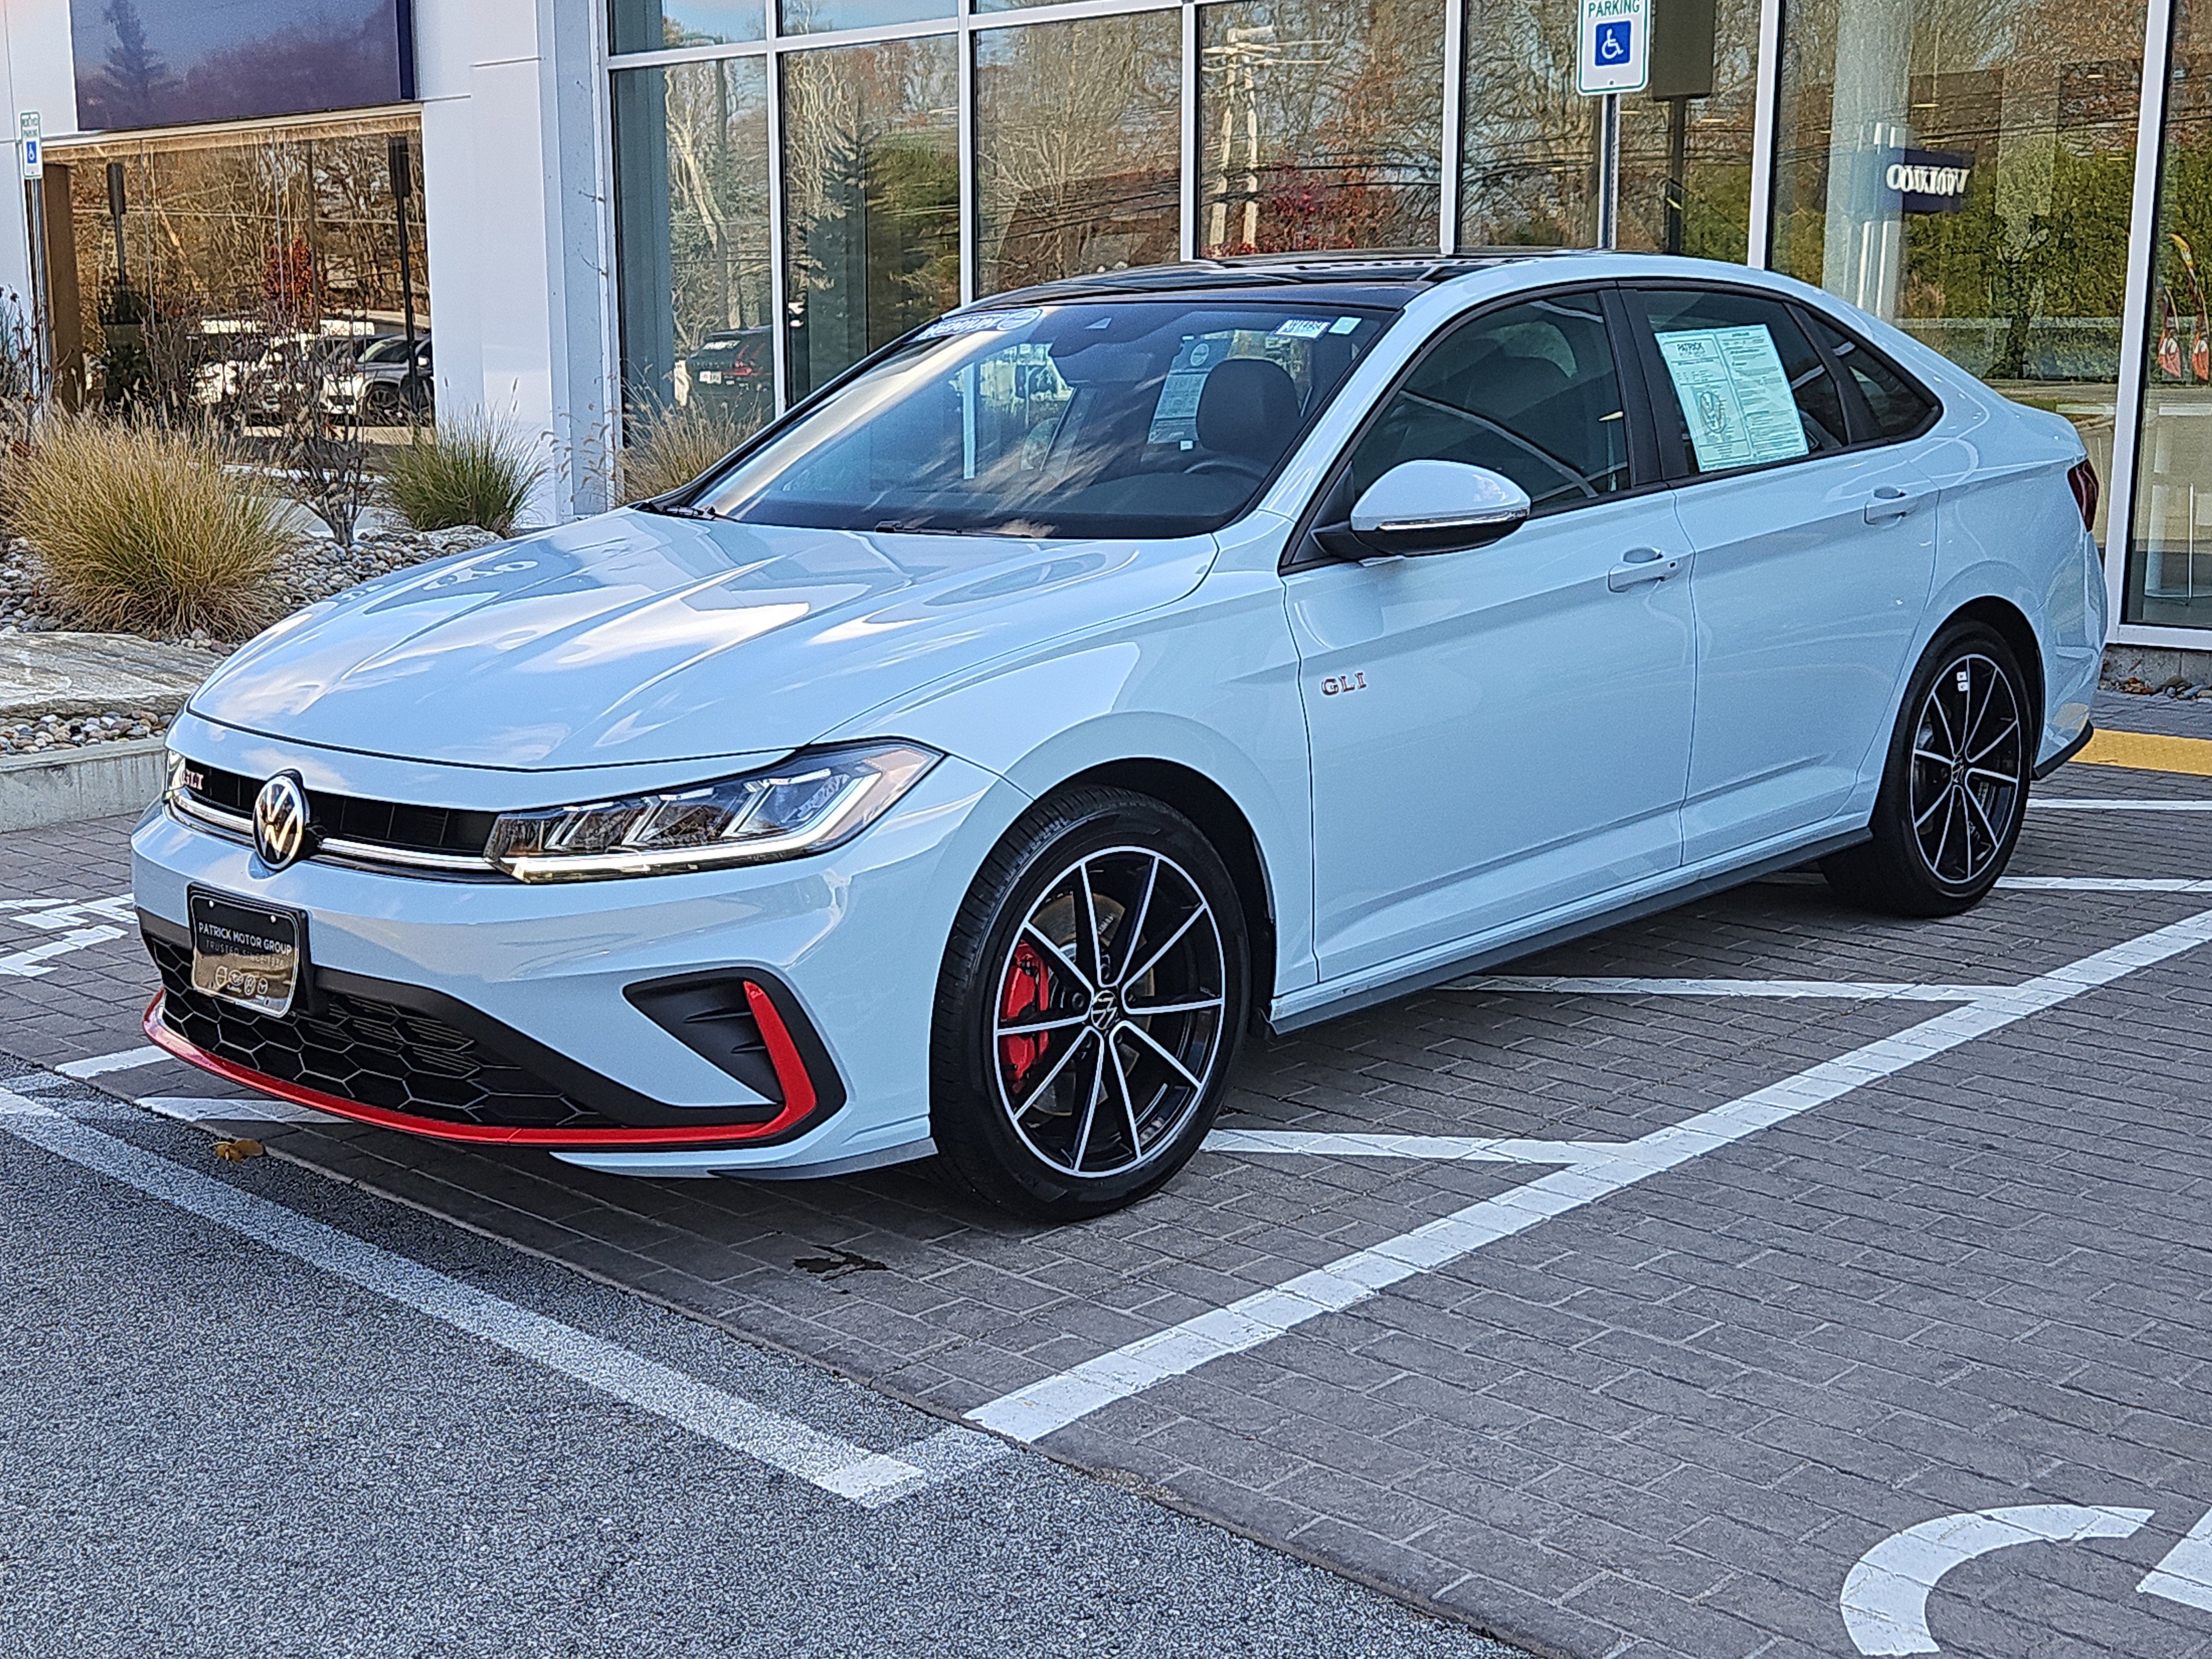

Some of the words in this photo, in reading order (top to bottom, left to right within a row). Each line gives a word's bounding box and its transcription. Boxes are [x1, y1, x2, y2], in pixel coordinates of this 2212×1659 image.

[1588, 0, 1641, 18] PARKING
[1321, 672, 1367, 696] GLI
[182, 769, 204, 790] GLI
[199, 922, 232, 940] PATRICK
[233, 931, 262, 948] MOTOR
[264, 940, 292, 956] GROUP
